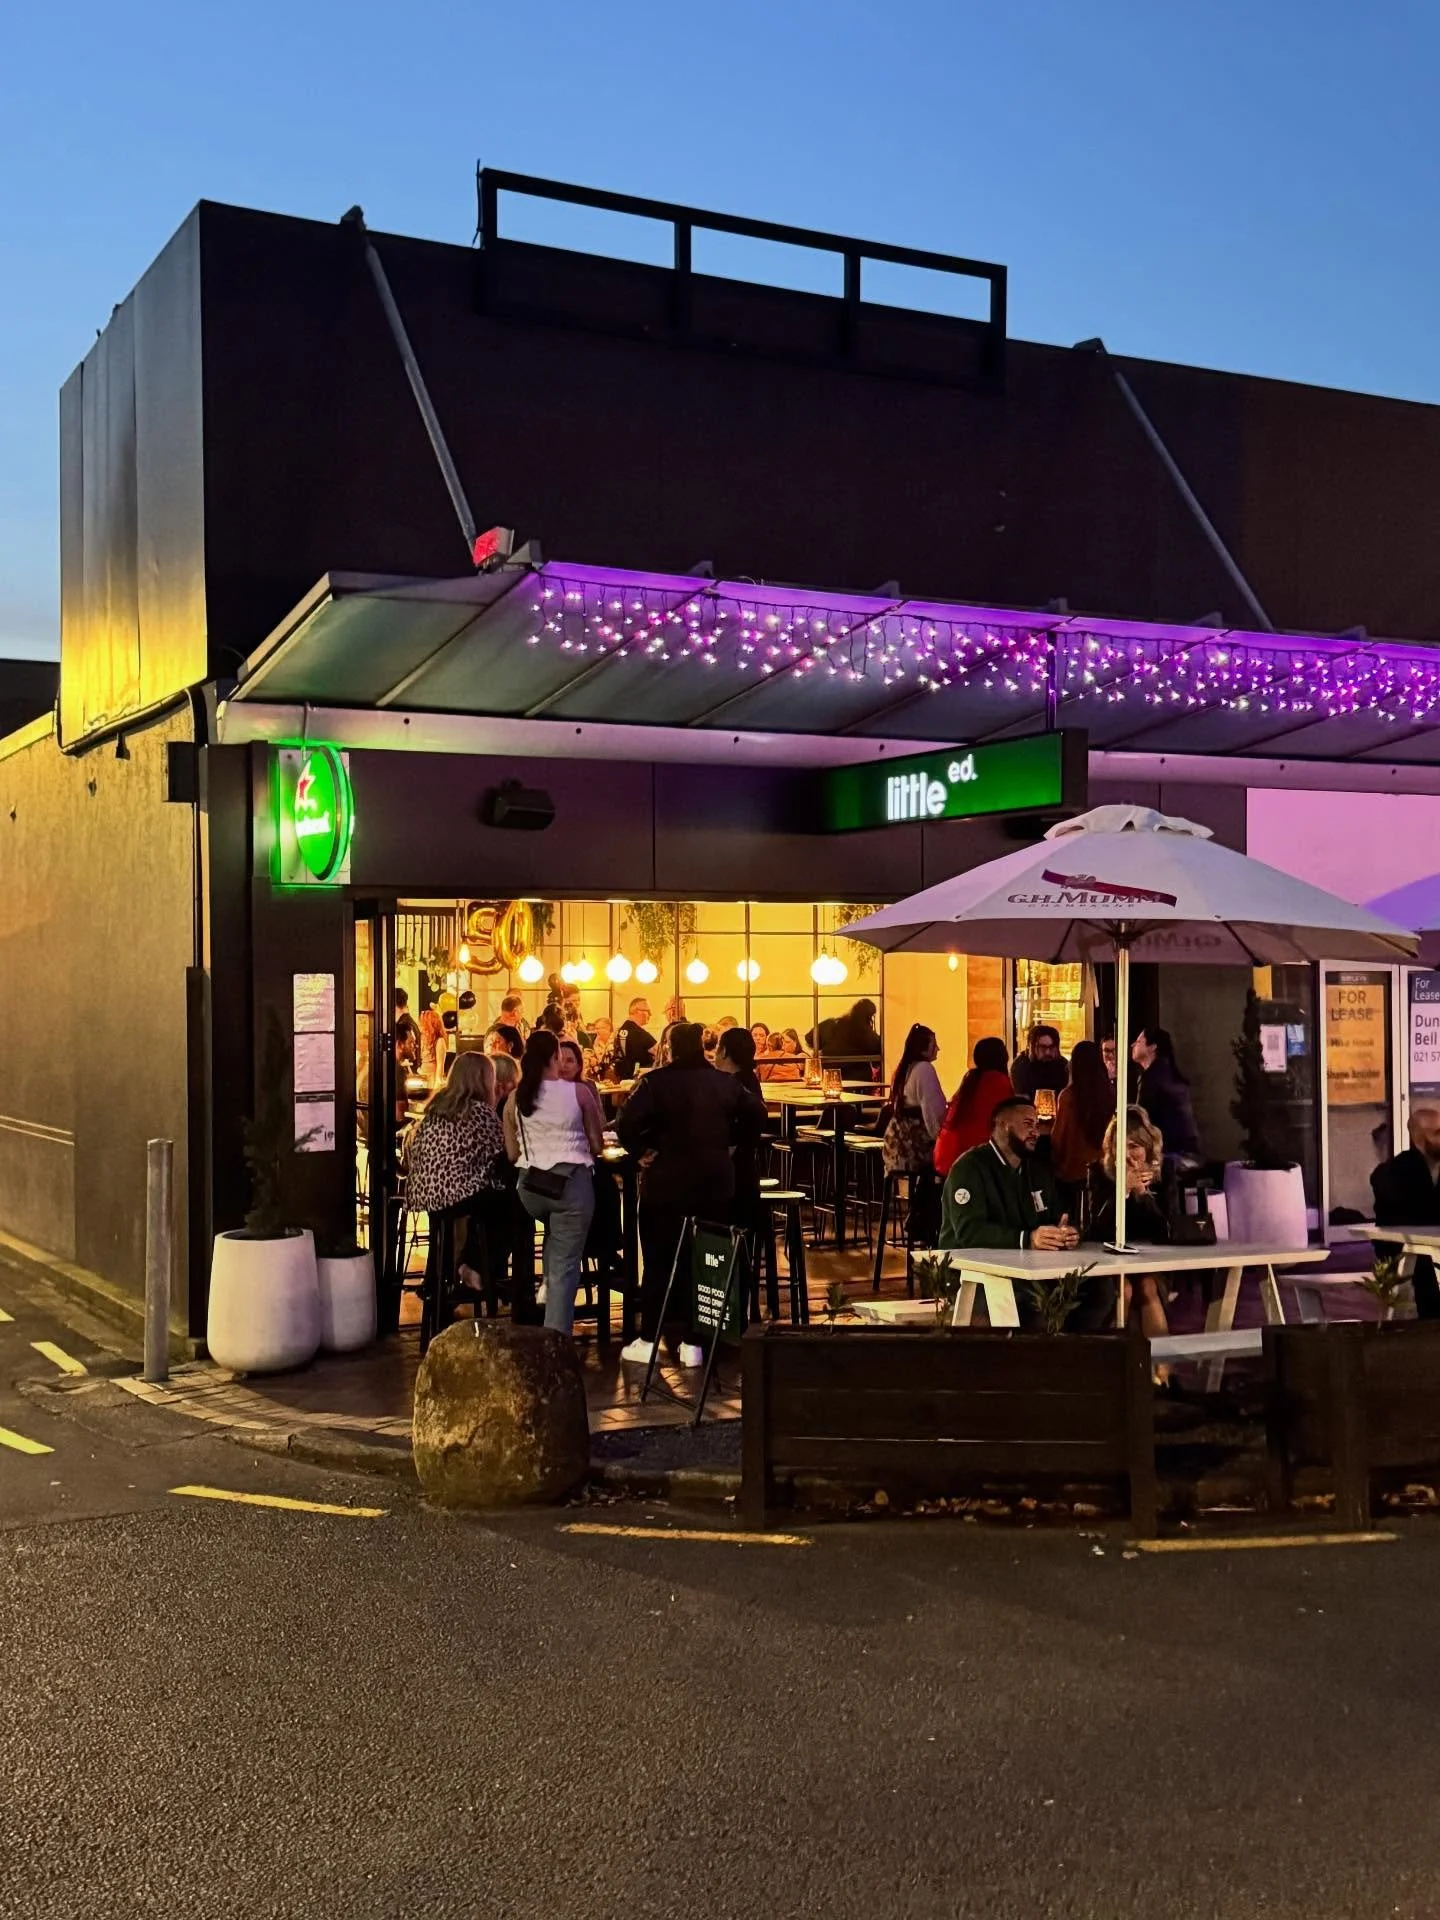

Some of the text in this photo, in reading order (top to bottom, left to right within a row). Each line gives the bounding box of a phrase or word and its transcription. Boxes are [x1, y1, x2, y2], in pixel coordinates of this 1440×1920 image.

[887, 771, 947, 821] little
[1415, 977, 1430, 989] For
[1338, 990, 1367, 1004] FOR
[1414, 990, 1440, 1001] Lease
[1331, 1008, 1374, 1022] LEASE
[1414, 1032, 1438, 1046] Bell
[697, 1284, 725, 1299] GOOD FOOD
[697, 1294, 712, 1305] GOOD
[697, 1304, 712, 1315] GOOD
[698, 1314, 712, 1325] GOOD
